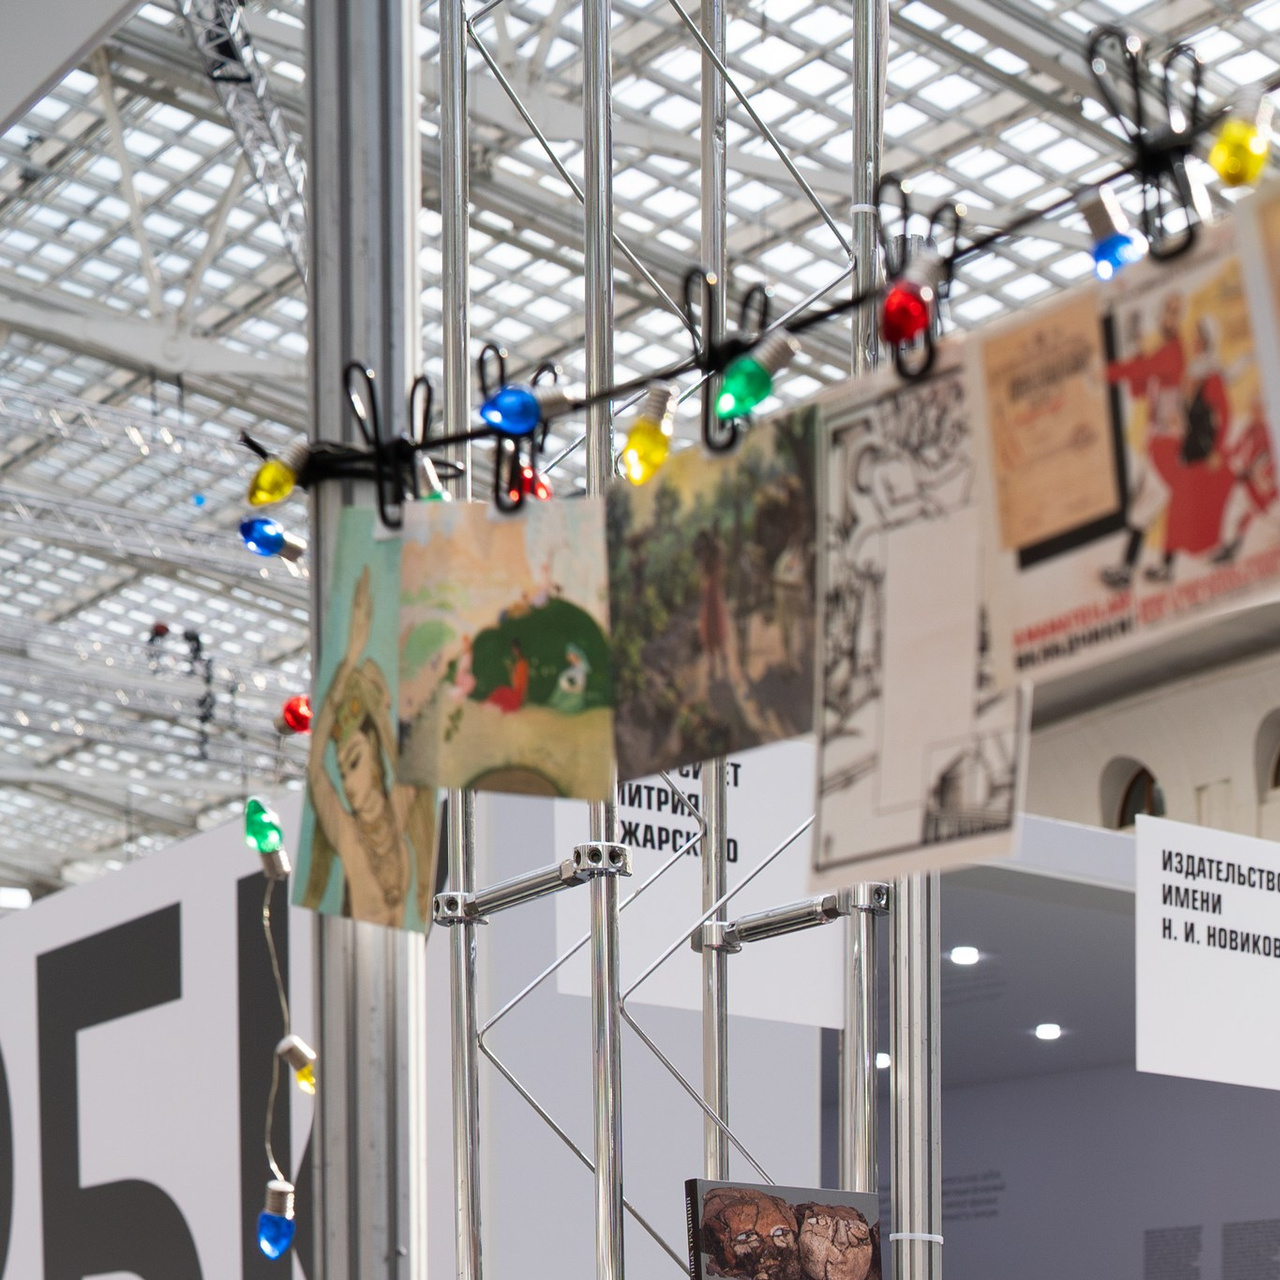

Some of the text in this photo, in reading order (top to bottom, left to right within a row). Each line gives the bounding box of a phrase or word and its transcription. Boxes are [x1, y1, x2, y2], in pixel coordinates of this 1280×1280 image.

[1162, 883, 1222, 915] ИМЕНИ
[1162, 917, 1177, 941] Н.
[1184, 921, 1200, 945] И.
